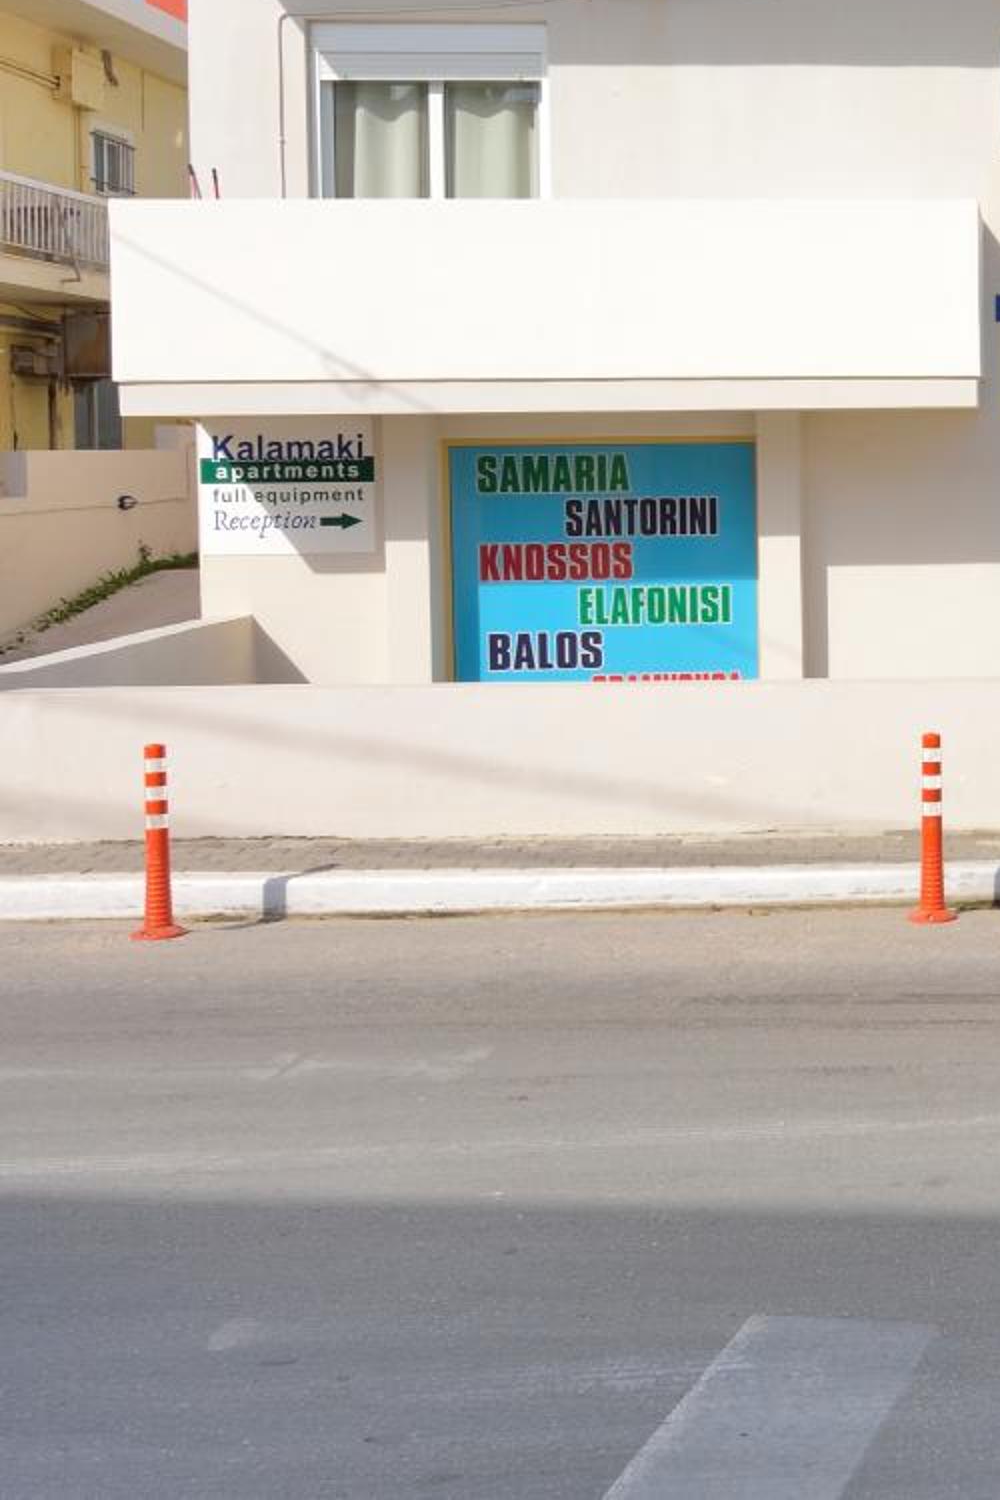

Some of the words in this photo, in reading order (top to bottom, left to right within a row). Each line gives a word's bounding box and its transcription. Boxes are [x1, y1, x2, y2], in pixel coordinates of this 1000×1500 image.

[211, 433, 364, 461] Kalamaki
[214, 463, 360, 483] apartments
[476, 452, 632, 494] SAMARIA
[212, 487, 247, 503] full
[254, 487, 364, 506] equipment
[213, 510, 318, 540] Reception
[564, 496, 719, 538] SANTORINI
[478, 542, 634, 582] KNOSSOS
[578, 584, 732, 626] ELAFONISI
[487, 630, 604, 672] BALOS
